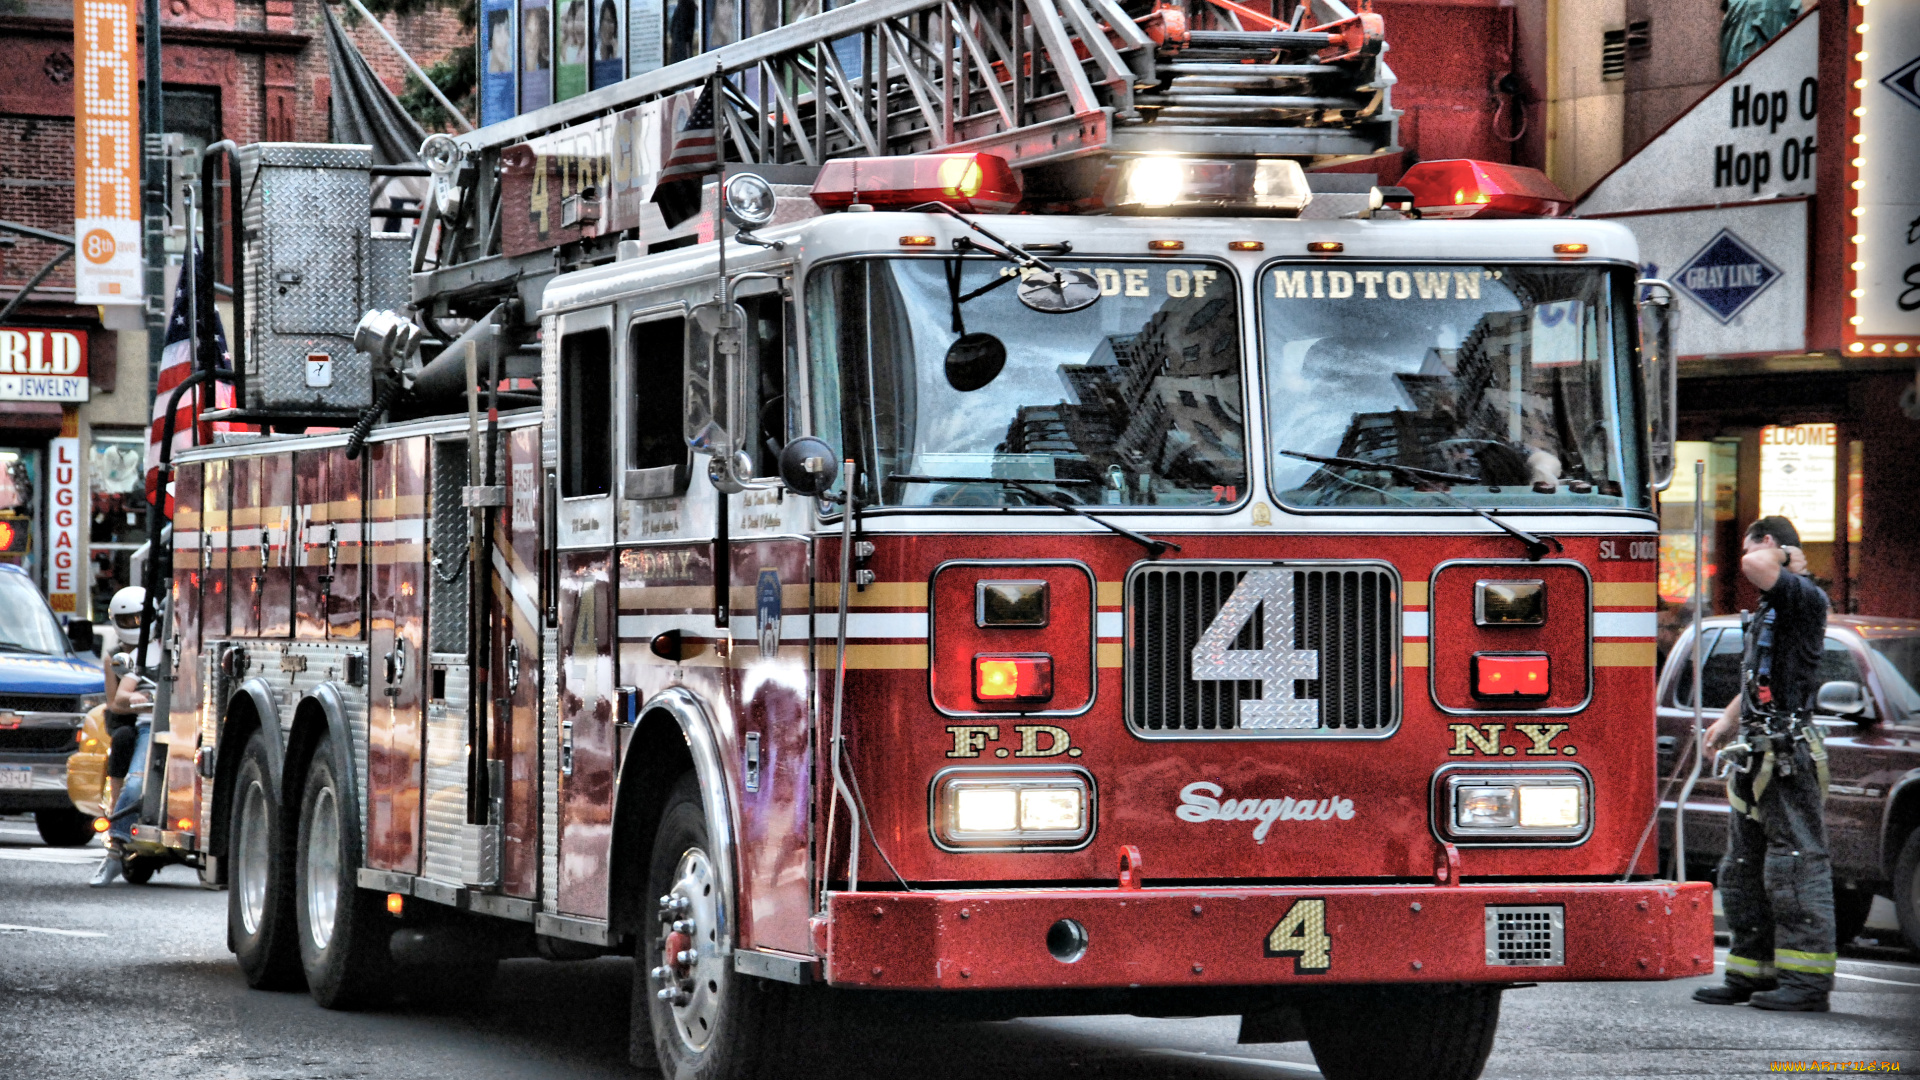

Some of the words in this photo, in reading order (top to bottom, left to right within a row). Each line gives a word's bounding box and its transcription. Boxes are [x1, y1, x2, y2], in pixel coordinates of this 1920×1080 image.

[1731, 84, 1788, 134] Hop
[1714, 144, 1770, 194] Hop
[530, 144, 550, 240] 4
[88, 234, 114, 258] 8th
[1166, 269, 1217, 298] OF
[1686, 265, 1728, 290] GRAY
[1728, 263, 1762, 287] LINE
[19, 378, 79, 397] JEWELRY
[514, 469, 533, 492] FAST
[55, 446, 73, 590] LUGGAGE
[516, 498, 531, 522] PAK
[1600, 541, 1620, 559] SL
[1191, 568, 1319, 729] 4
[945, 725, 1083, 759] F.D.
[1447, 723, 1578, 757] N.Y.
[1175, 781, 1357, 845] Seagrave
[1265, 897, 1331, 975] 4
